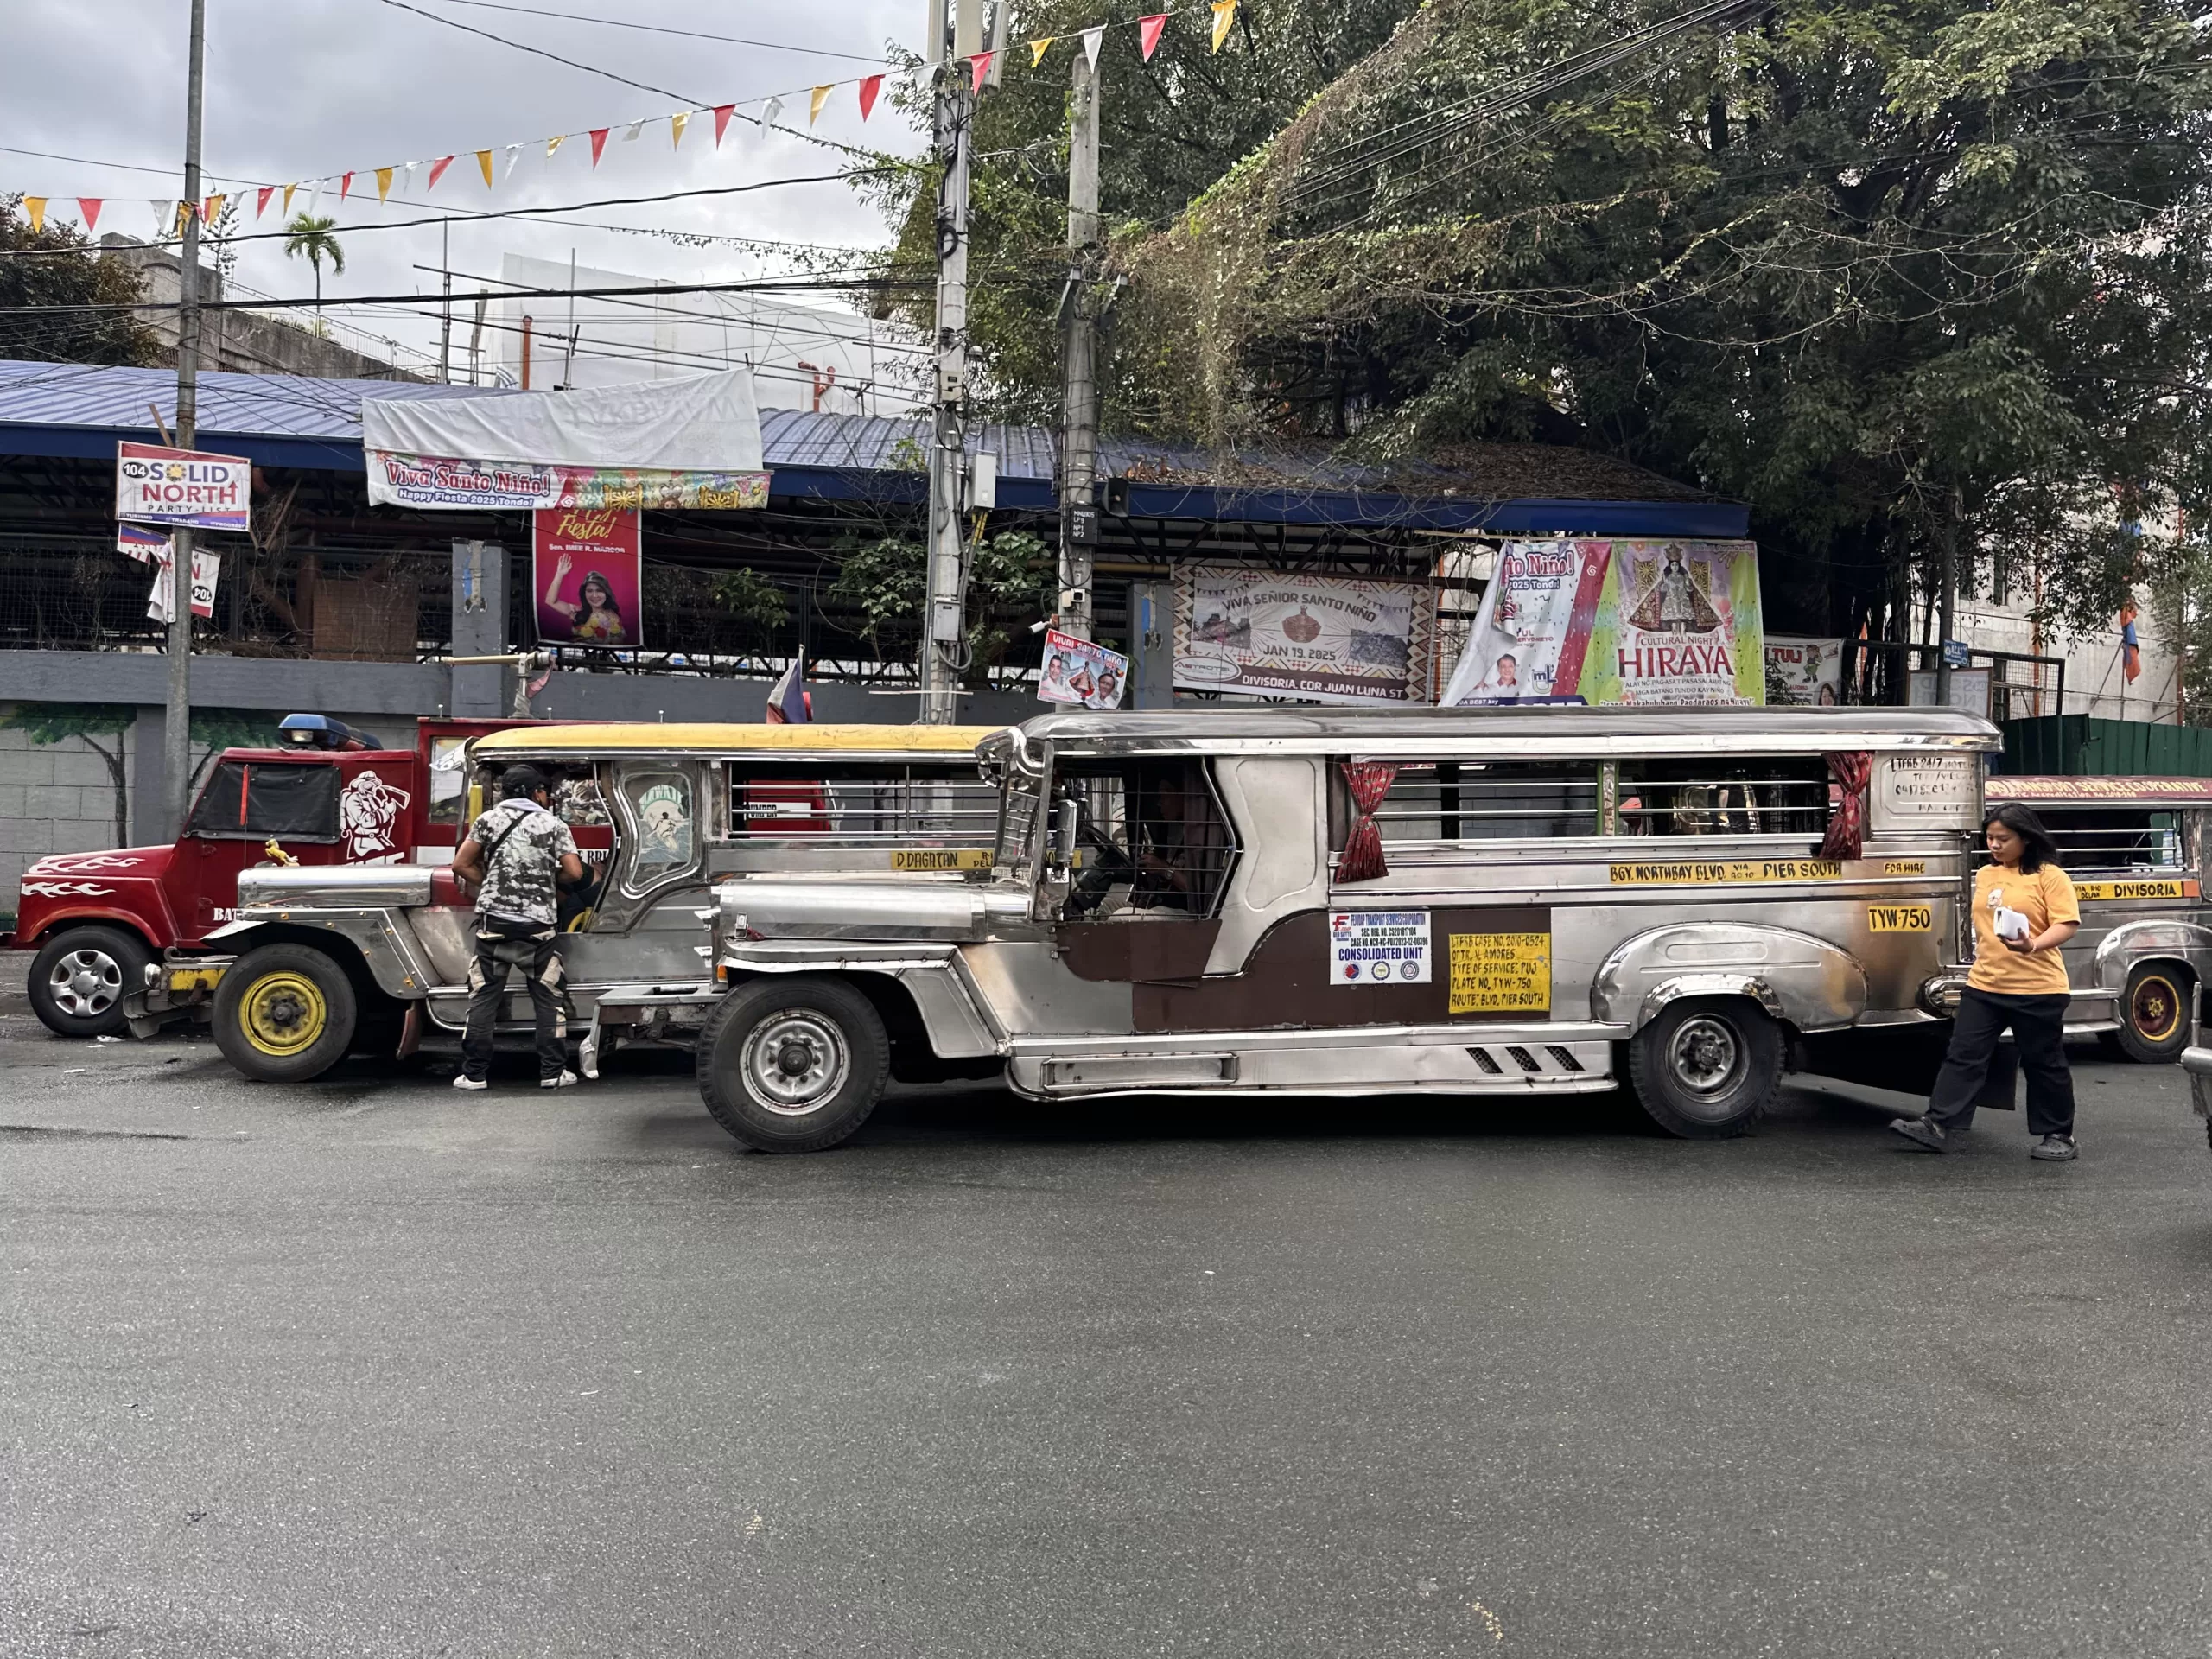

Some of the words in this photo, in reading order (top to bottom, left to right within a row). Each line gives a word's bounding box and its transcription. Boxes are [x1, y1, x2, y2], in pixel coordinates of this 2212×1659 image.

[124, 463, 147, 477] 104
[386, 461, 431, 486] Viva
[435, 465, 491, 491] Santo
[495, 470, 550, 495] Niño!
[143, 481, 238, 505] NORTH
[398, 490, 432, 503] Happy
[435, 493, 467, 504] Fiesta
[471, 495, 495, 505] 2025
[499, 497, 533, 507] Tondo!
[556, 513, 617, 539] Fiesta!
[1527, 550, 1574, 576] Niño!
[194, 586, 213, 601] 104
[1222, 596, 1251, 611] VIVA
[1254, 590, 1299, 605] SEÑIOR
[1301, 594, 1343, 610] SANTO
[1344, 603, 1377, 623] NIÑO
[1641, 636, 1685, 645] CULTURAL
[1688, 636, 1714, 645] NIGHT
[1077, 642, 1102, 657] SANTO
[1103, 652, 1122, 666] NIÑO
[1263, 645, 1288, 656] JAN
[1309, 649, 1337, 661] 2025
[1772, 647, 1802, 664] TULI
[1618, 646, 1735, 677] HIRAYA
[1300, 680, 1322, 691] COR
[1325, 683, 1355, 695] JUAN
[1357, 686, 1387, 697] LUNA
[1389, 690, 1403, 698] ST
[2075, 780, 2126, 792] SERVICE
[2125, 780, 2209, 792] COOPERATIVE
[1610, 866, 1634, 881] BGY.
[1636, 865, 1692, 881] NORTHBAY
[1695, 864, 1726, 880] BLVD.
[1764, 862, 1796, 878] PIER
[1800, 862, 1842, 877] SOUTH
[1885, 863, 1903, 874] FOR
[1904, 861, 1925, 874] HIRE
[2113, 882, 2177, 898] DIVISORIA
[1365, 913, 1385, 926] TRANSPORT
[1386, 913, 1402, 925] SERVICES
[1402, 912, 1426, 925] CORPORATION
[1350, 938, 1362, 947] CASE
[1452, 936, 1472, 948] LTFRB
[1475, 936, 1492, 947] CASE
[1506, 935, 1545, 947] 2010-0524
[1338, 947, 1402, 961] CONSOLIDATED
[1403, 947, 1423, 959] UNIT
[1484, 949, 1516, 960] AMORES
[1452, 963, 1471, 975] TYPE
[1473, 963, 1482, 974] OF
[1484, 962, 1519, 975] SERVICE:
[1521, 962, 1537, 975] PUJ
[1452, 977, 1476, 990] PLATE
[1478, 977, 1491, 991] NO.
[1493, 977, 1532, 988] TYW-750
[1452, 994, 1479, 1007] ROUTE:
[1481, 993, 1499, 1007] BLVD.
[1502, 993, 1517, 1006] PIER
[1519, 993, 1544, 1005] SOUTH
